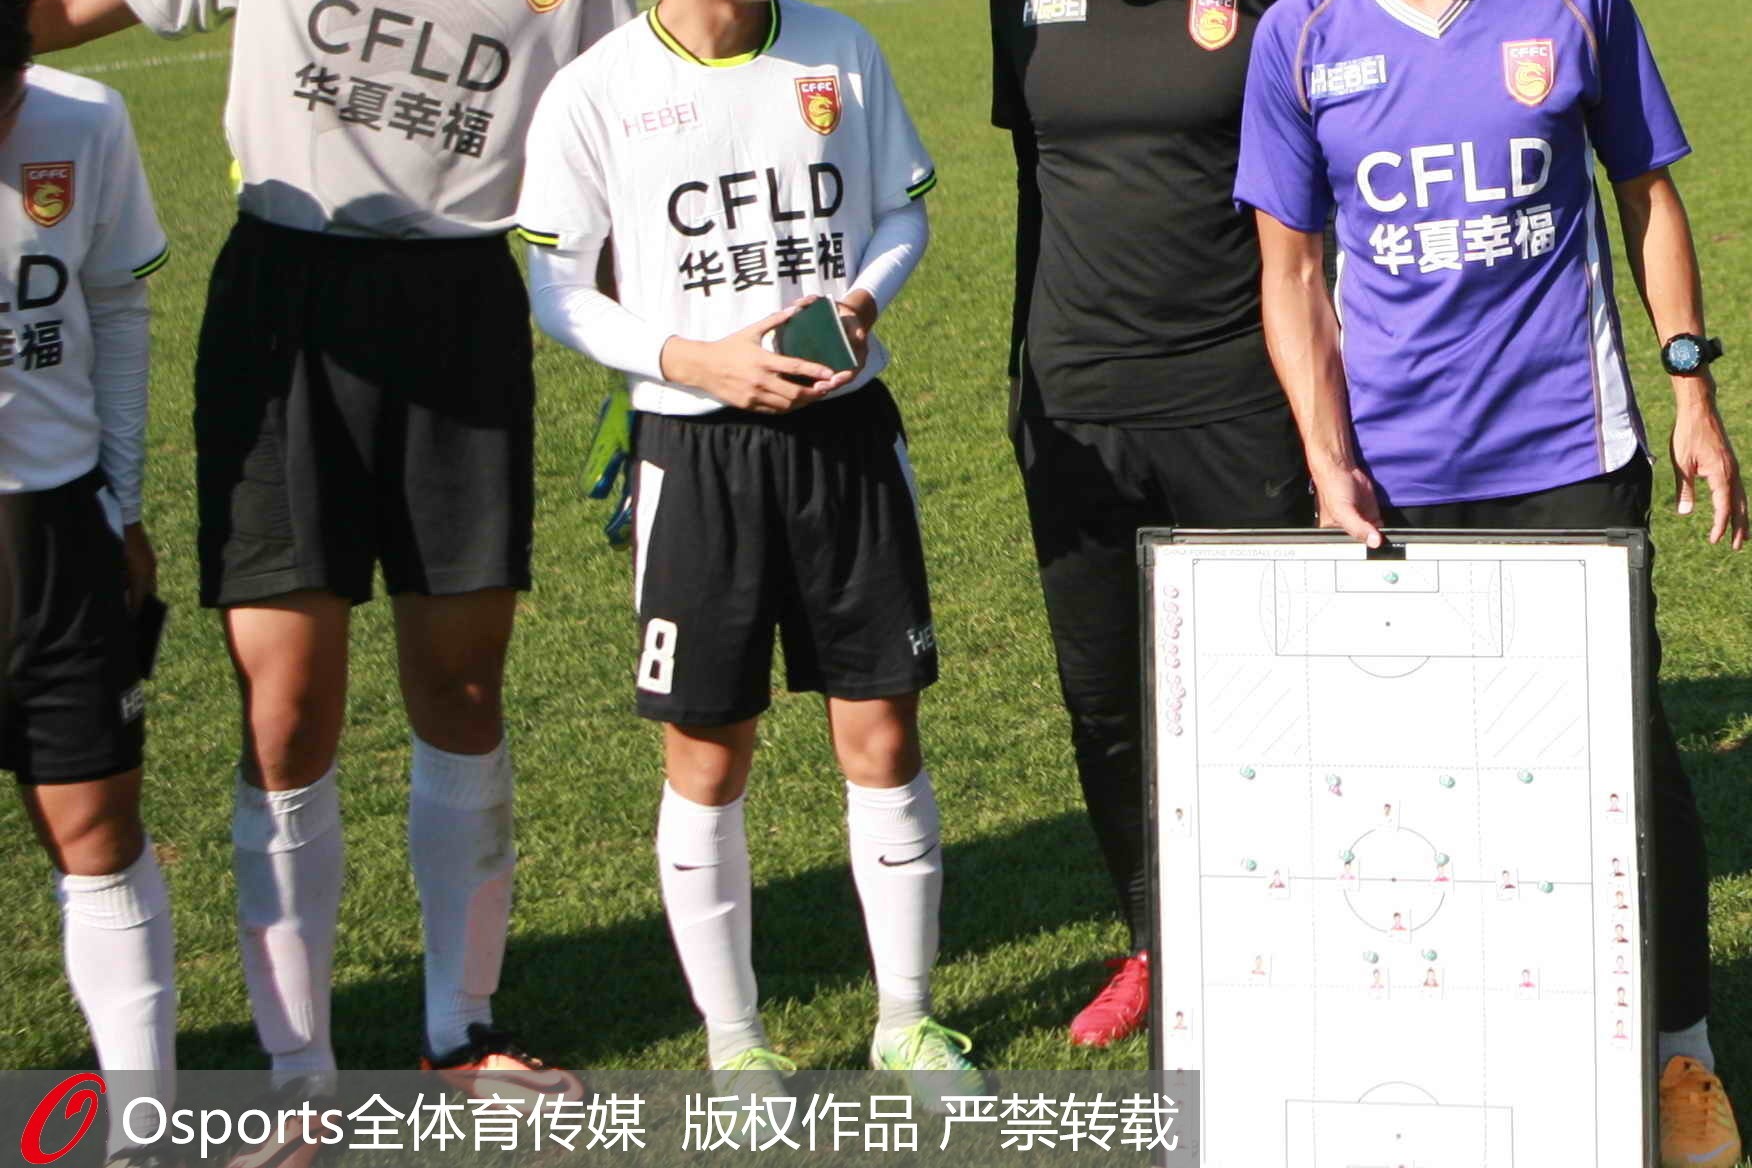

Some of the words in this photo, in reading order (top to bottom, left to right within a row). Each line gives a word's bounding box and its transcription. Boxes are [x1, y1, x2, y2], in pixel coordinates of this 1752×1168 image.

[294, 62, 492, 159] 华夏幸福
[1311, 58, 1387, 95] HEBEI
[622, 101, 698, 138] HEBEI
[667, 162, 844, 237] CFLD
[1356, 138, 1553, 213] CFLD
[679, 232, 847, 298] 华夏幸福
[1368, 203, 1557, 276] 华夏幸福
[636, 617, 678, 695] 8
